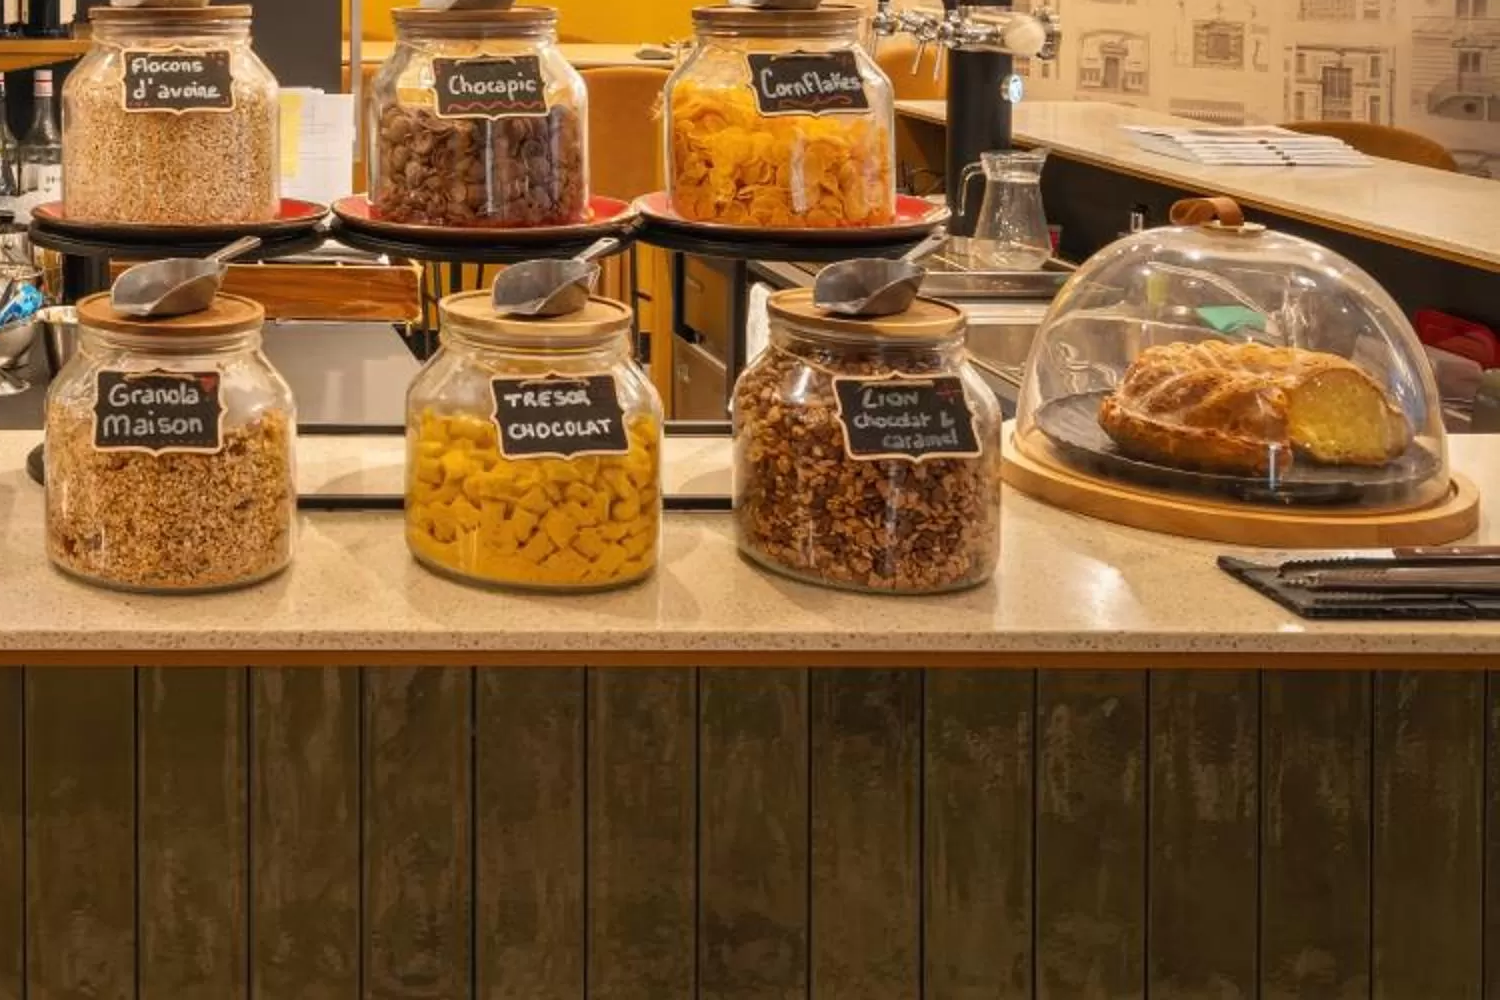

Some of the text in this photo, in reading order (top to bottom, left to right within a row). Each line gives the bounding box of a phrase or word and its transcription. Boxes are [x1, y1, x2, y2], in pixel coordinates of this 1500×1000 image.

[131, 57, 204, 75] Flocons
[449, 71, 537, 102] Chocapic
[108, 382, 200, 407] Granola
[504, 390, 592, 408] TRESOR
[102, 410, 203, 437] Maison
[508, 418, 612, 440] CHOCOLAT
[882, 429, 959, 449] caramel
